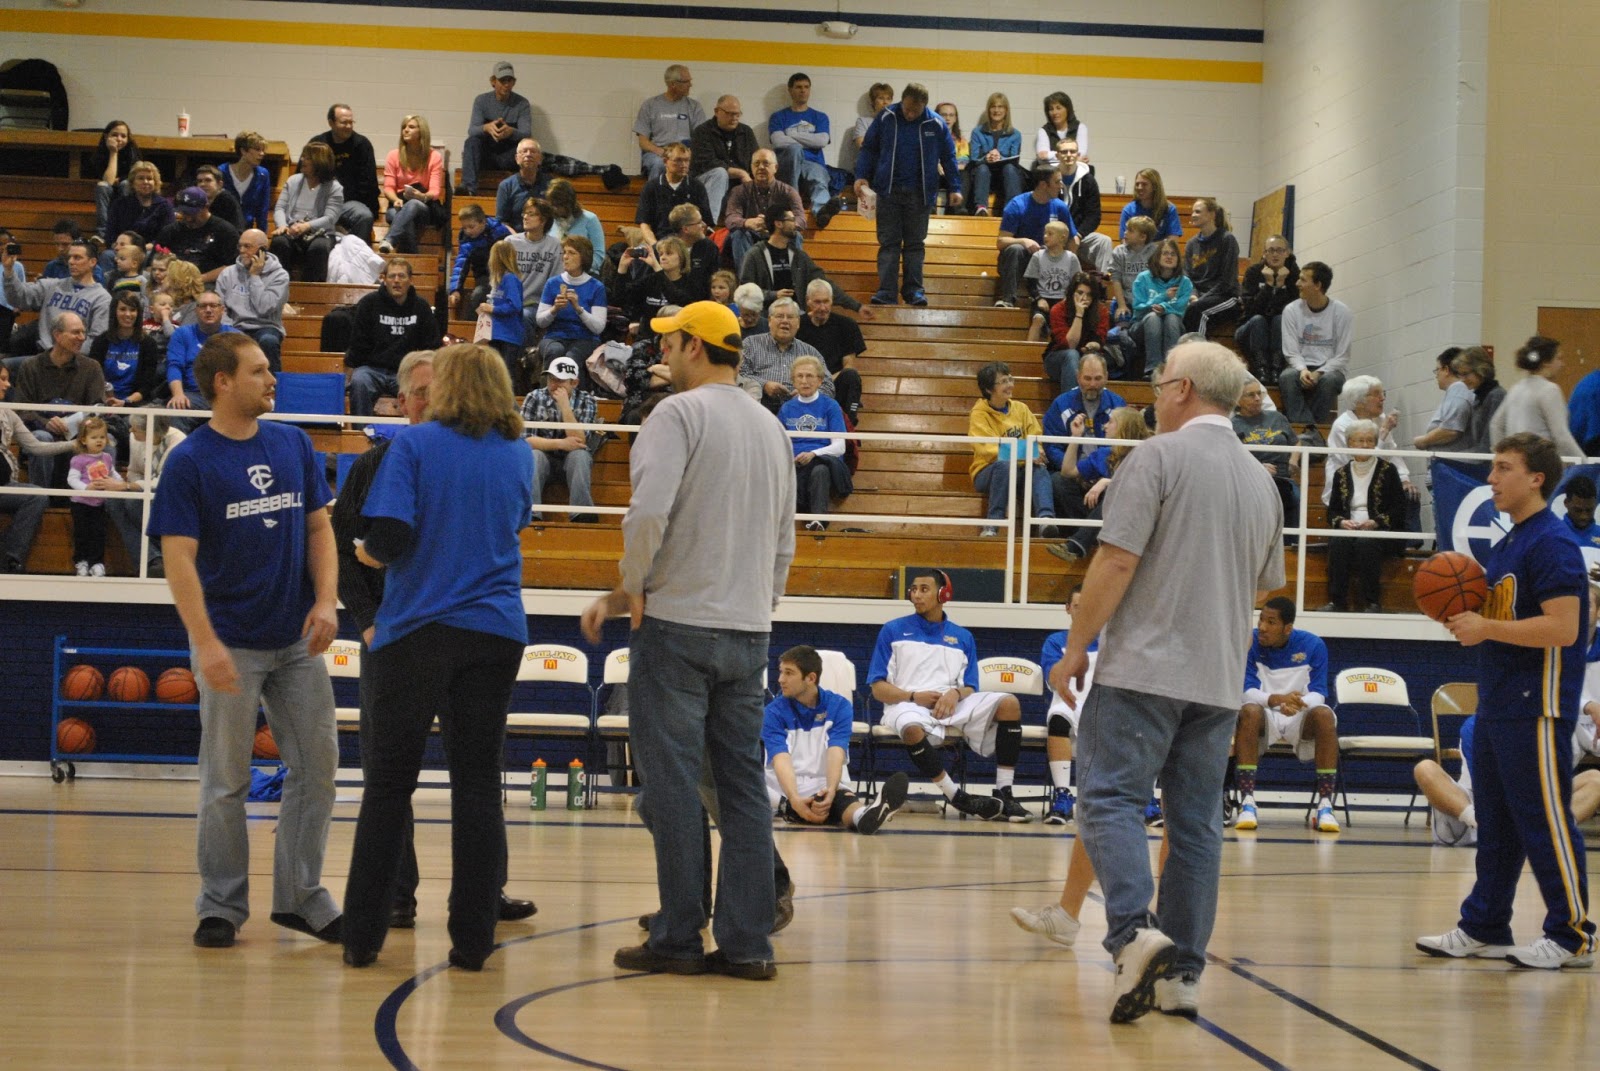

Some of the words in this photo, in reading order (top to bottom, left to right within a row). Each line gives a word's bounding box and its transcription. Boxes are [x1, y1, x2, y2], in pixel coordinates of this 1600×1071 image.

[342, 646, 360, 656] JAY
[525, 650, 551, 661] BLUE
[552, 650, 577, 662] JAYS
[616, 653, 629, 664] BL
[982, 664, 1007, 673] BLUE
[1008, 664, 1034, 676] JAYS
[1346, 673, 1370, 683] BLUE
[1371, 674, 1396, 685] JAYS
